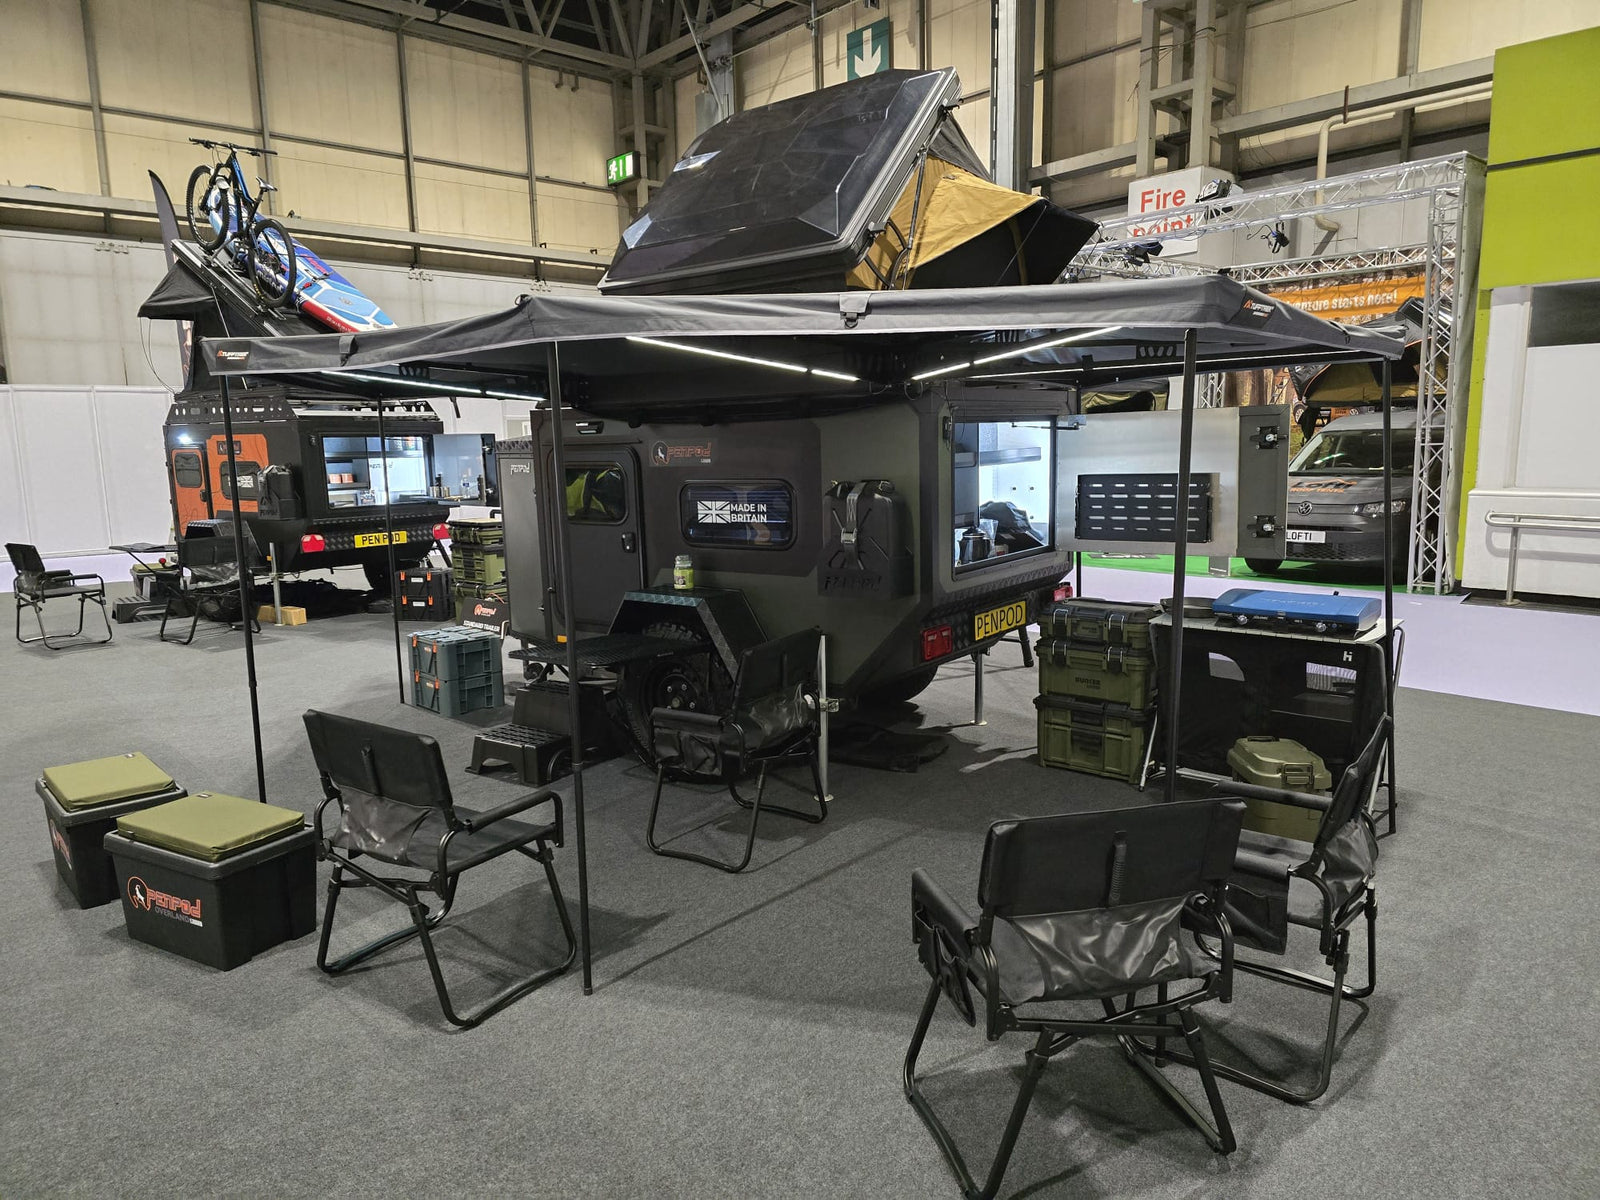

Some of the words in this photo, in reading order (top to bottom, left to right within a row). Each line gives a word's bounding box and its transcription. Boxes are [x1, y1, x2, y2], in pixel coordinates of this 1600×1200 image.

[1140, 188, 1186, 213] Fire
[1331, 294, 1365, 310] starts
[731, 503, 756, 512] MADE
[757, 503, 767, 512] IN
[731, 513, 767, 523] BRITAIN
[1286, 531, 1312, 541] LOFTI
[976, 604, 1023, 638] PENPOD
[154, 905, 190, 923] OVERLAND
